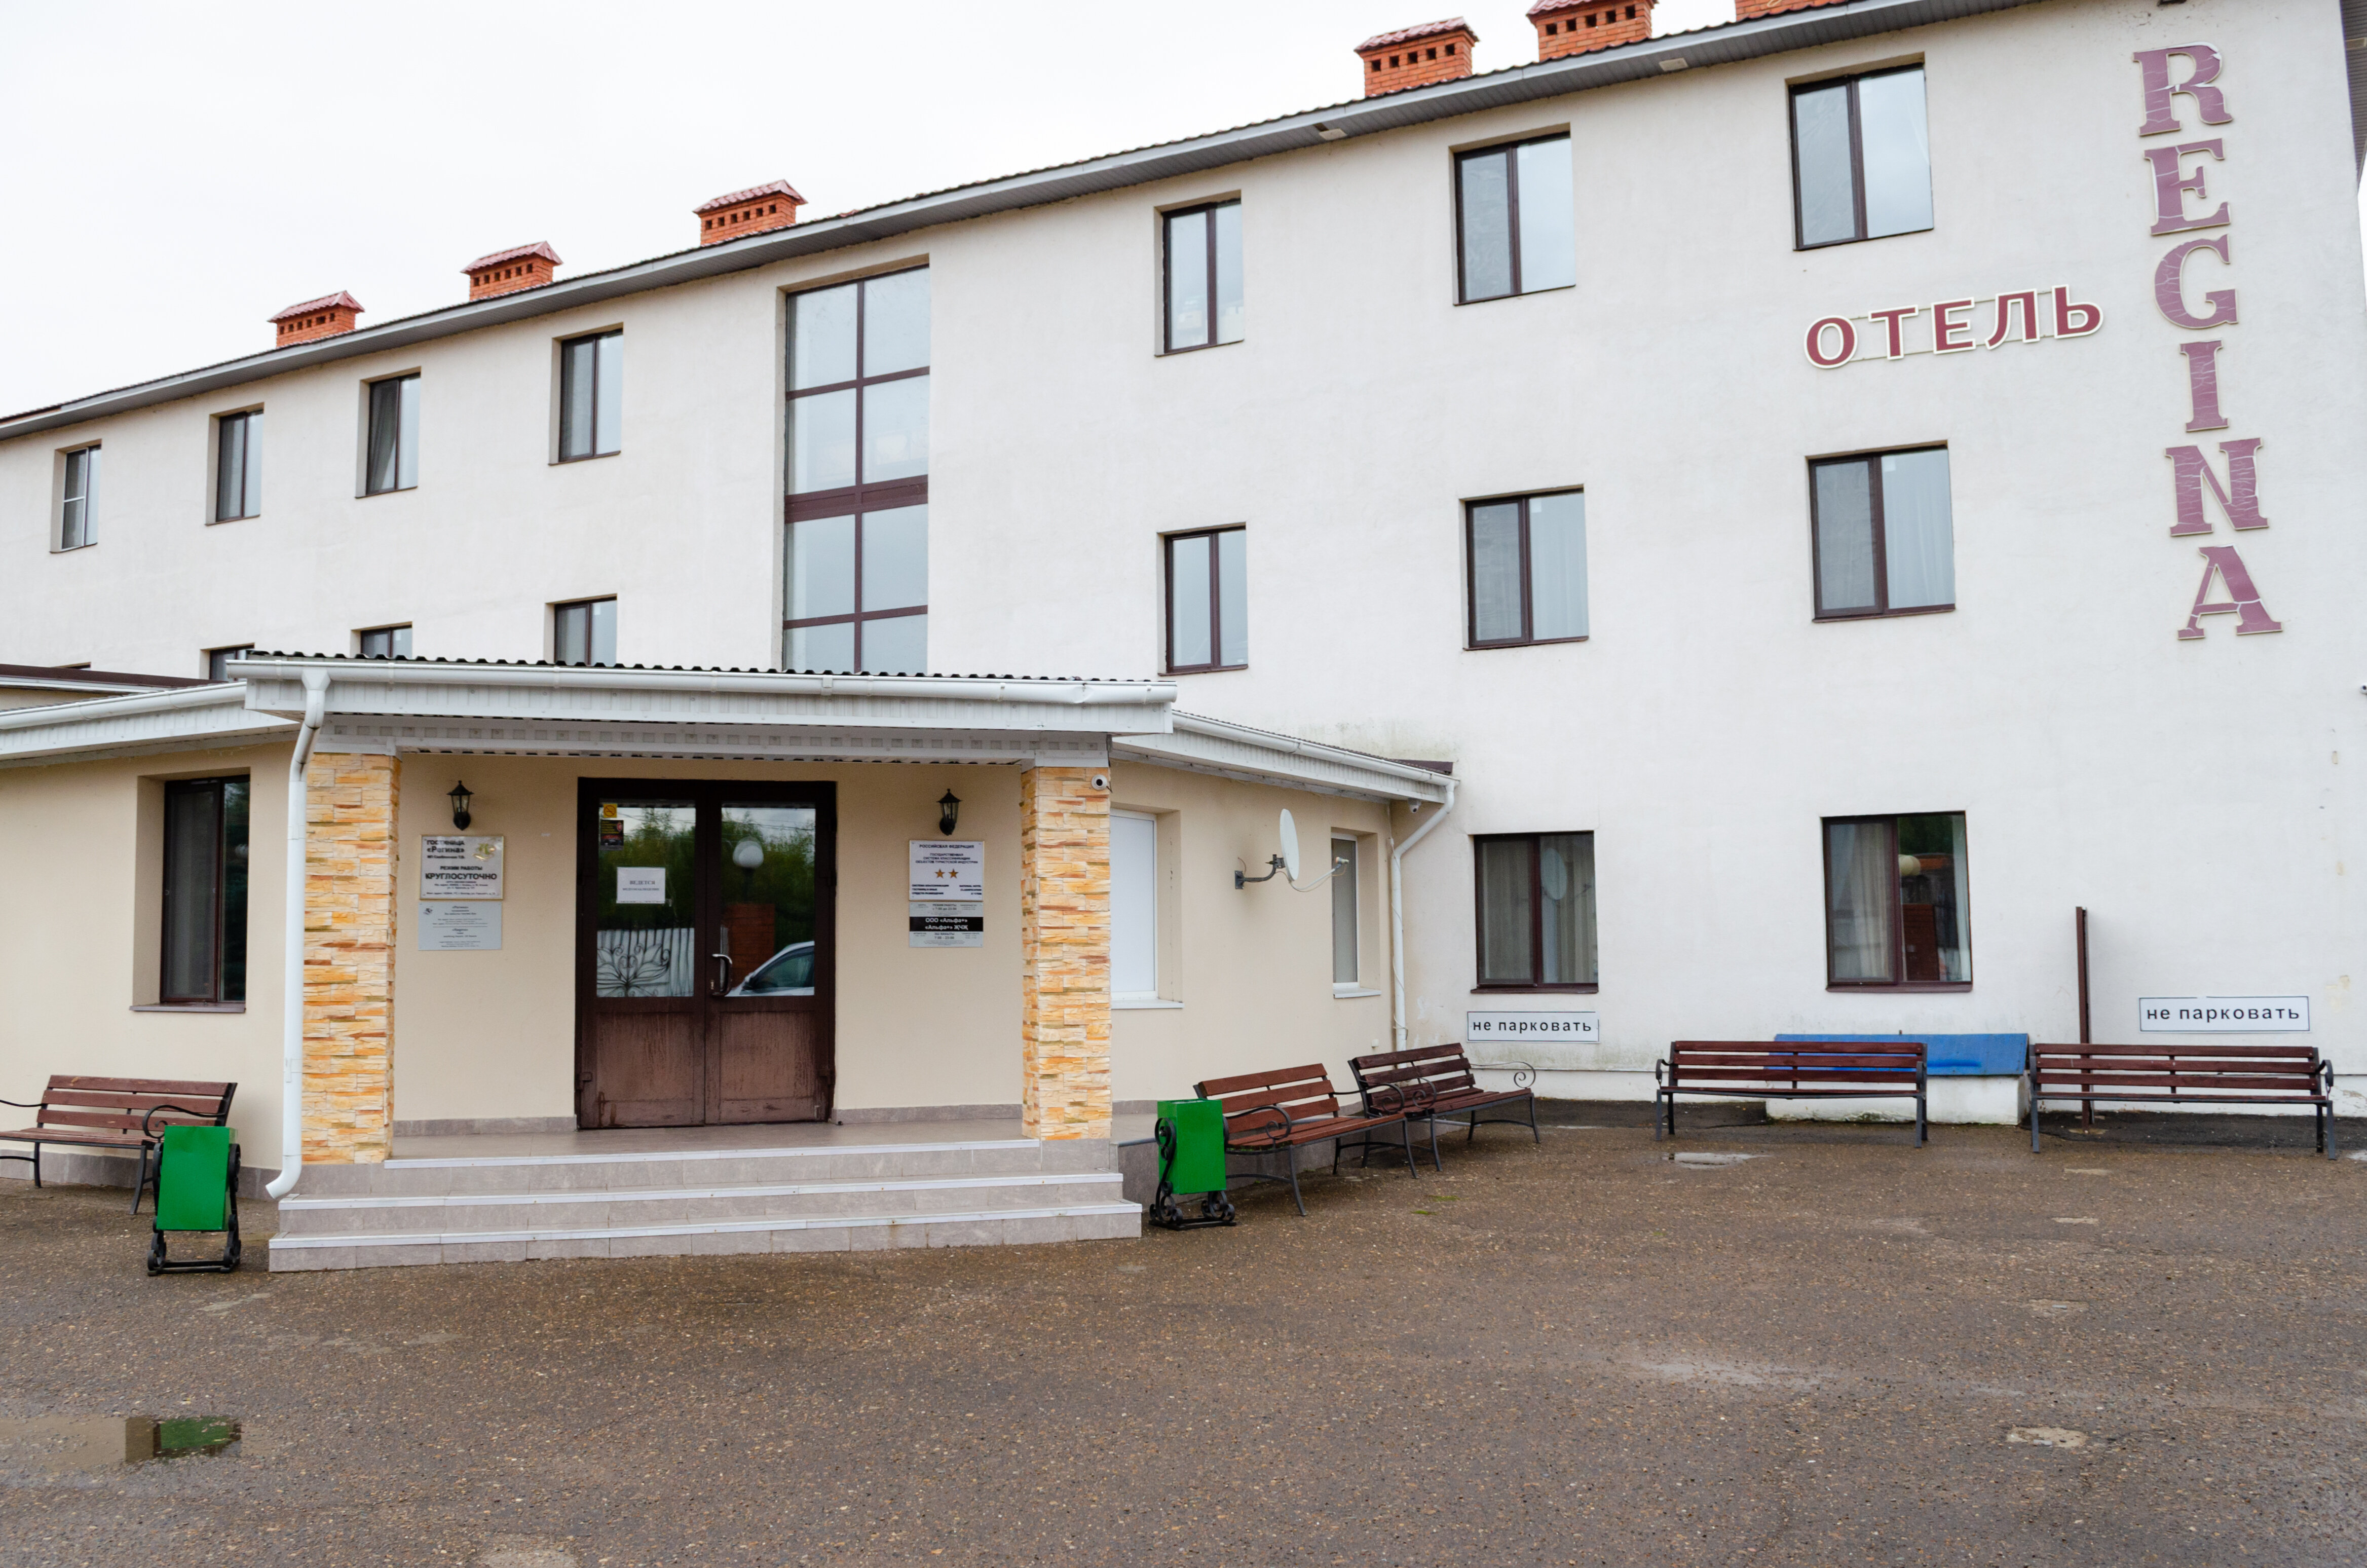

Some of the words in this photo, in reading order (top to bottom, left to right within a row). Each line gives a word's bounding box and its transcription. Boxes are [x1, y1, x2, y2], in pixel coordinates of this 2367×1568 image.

[1804, 284, 2103, 368] ОТЕЛЬ
[2132, 41, 2282, 640] REGINA
[1473, 1021, 1491, 1031] не
[1498, 1021, 1591, 1033] парковать
[2147, 1009, 2170, 1020] не
[2180, 1008, 2300, 1023] парковать
